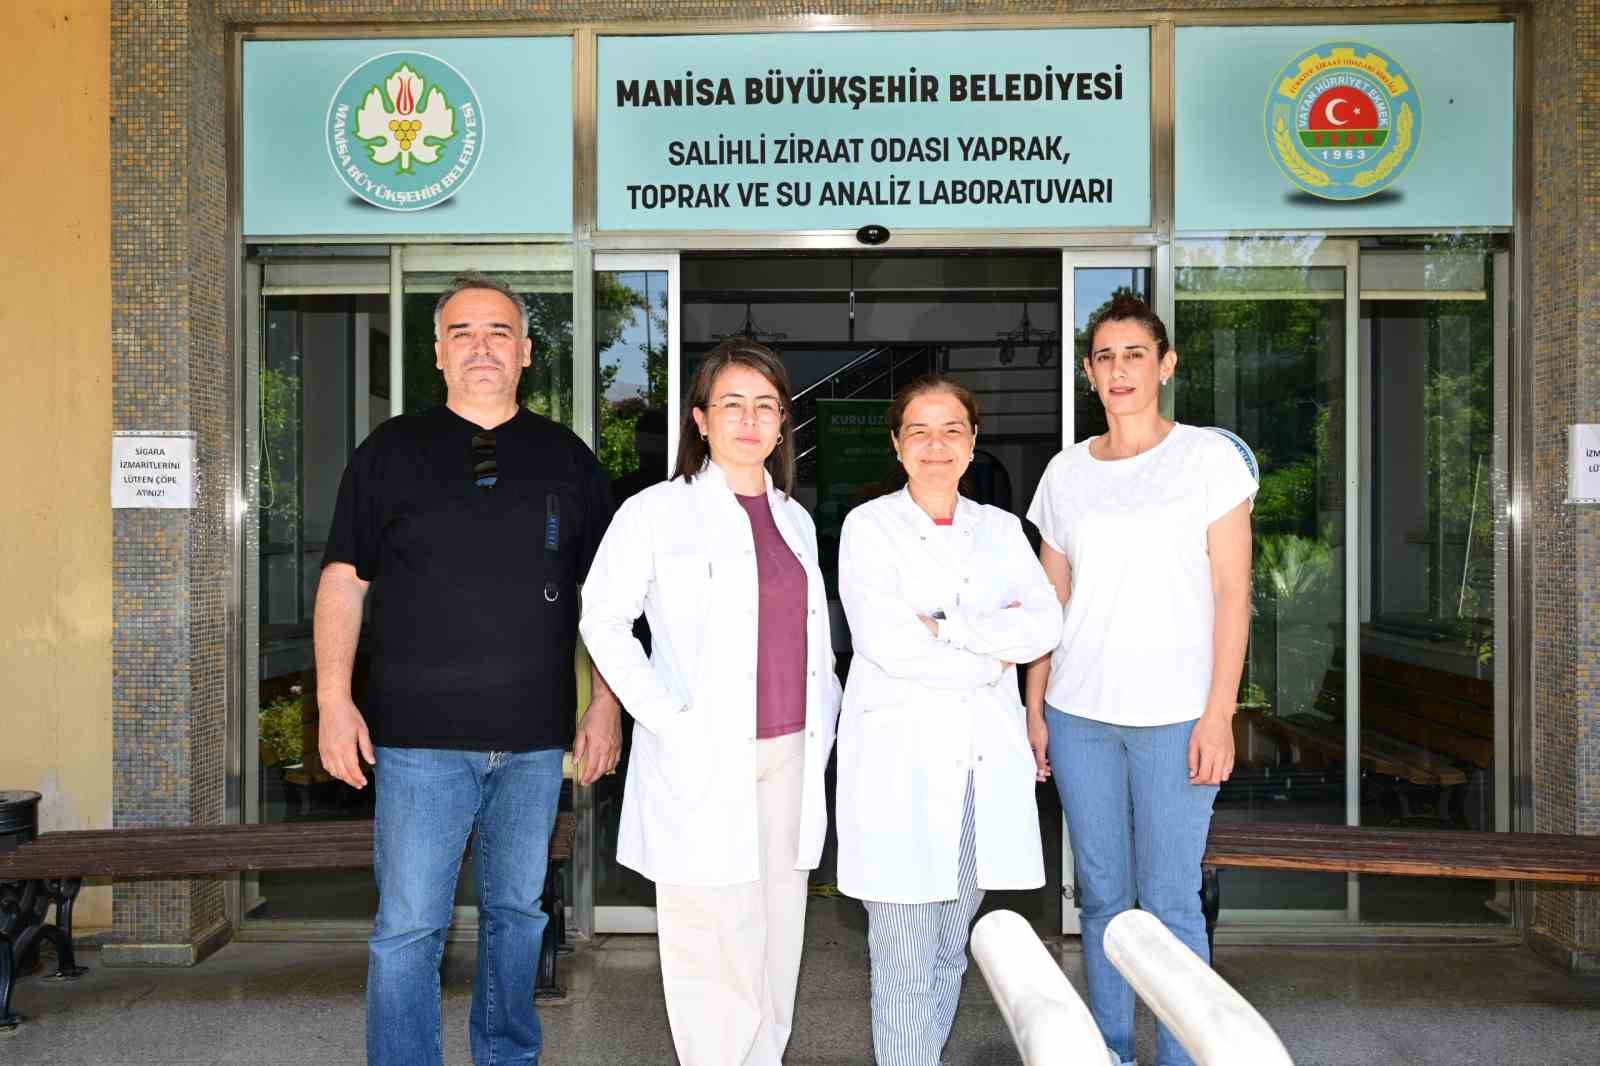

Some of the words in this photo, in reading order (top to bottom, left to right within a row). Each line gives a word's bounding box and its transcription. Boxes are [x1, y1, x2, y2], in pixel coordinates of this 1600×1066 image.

[616, 70, 735, 107] MANİSA
[746, 66, 939, 110] BÜYÜKŞEHİR
[949, 64, 1123, 102] BELEDİYESİ
[1299, 91, 1316, 127] VATAN
[1368, 87, 1390, 127] EKMEK
[333, 103, 352, 167] MANİSA
[348, 164, 442, 206] BÜYÜKŞEHİR
[440, 102, 477, 188] BELEDİYESİ
[668, 133, 766, 166] SALİHLİ
[774, 132, 864, 164] ZİRAAT
[871, 137, 949, 163] ODASI
[957, 135, 1071, 165] YAPRAK,
[1321, 150, 1366, 160] 1963
[626, 183, 730, 210] TOPRAK
[738, 182, 769, 207] VE
[777, 181, 811, 207] SU
[818, 174, 911, 206] ANALİZ
[919, 178, 1113, 205] LABORATUVARI
[119, 460, 181, 470] İZMARİTLERİNİ
[135, 447, 166, 456] SİGARA
[123, 475, 154, 485] LÜTFEN
[155, 474, 177, 486] ÇÖPE
